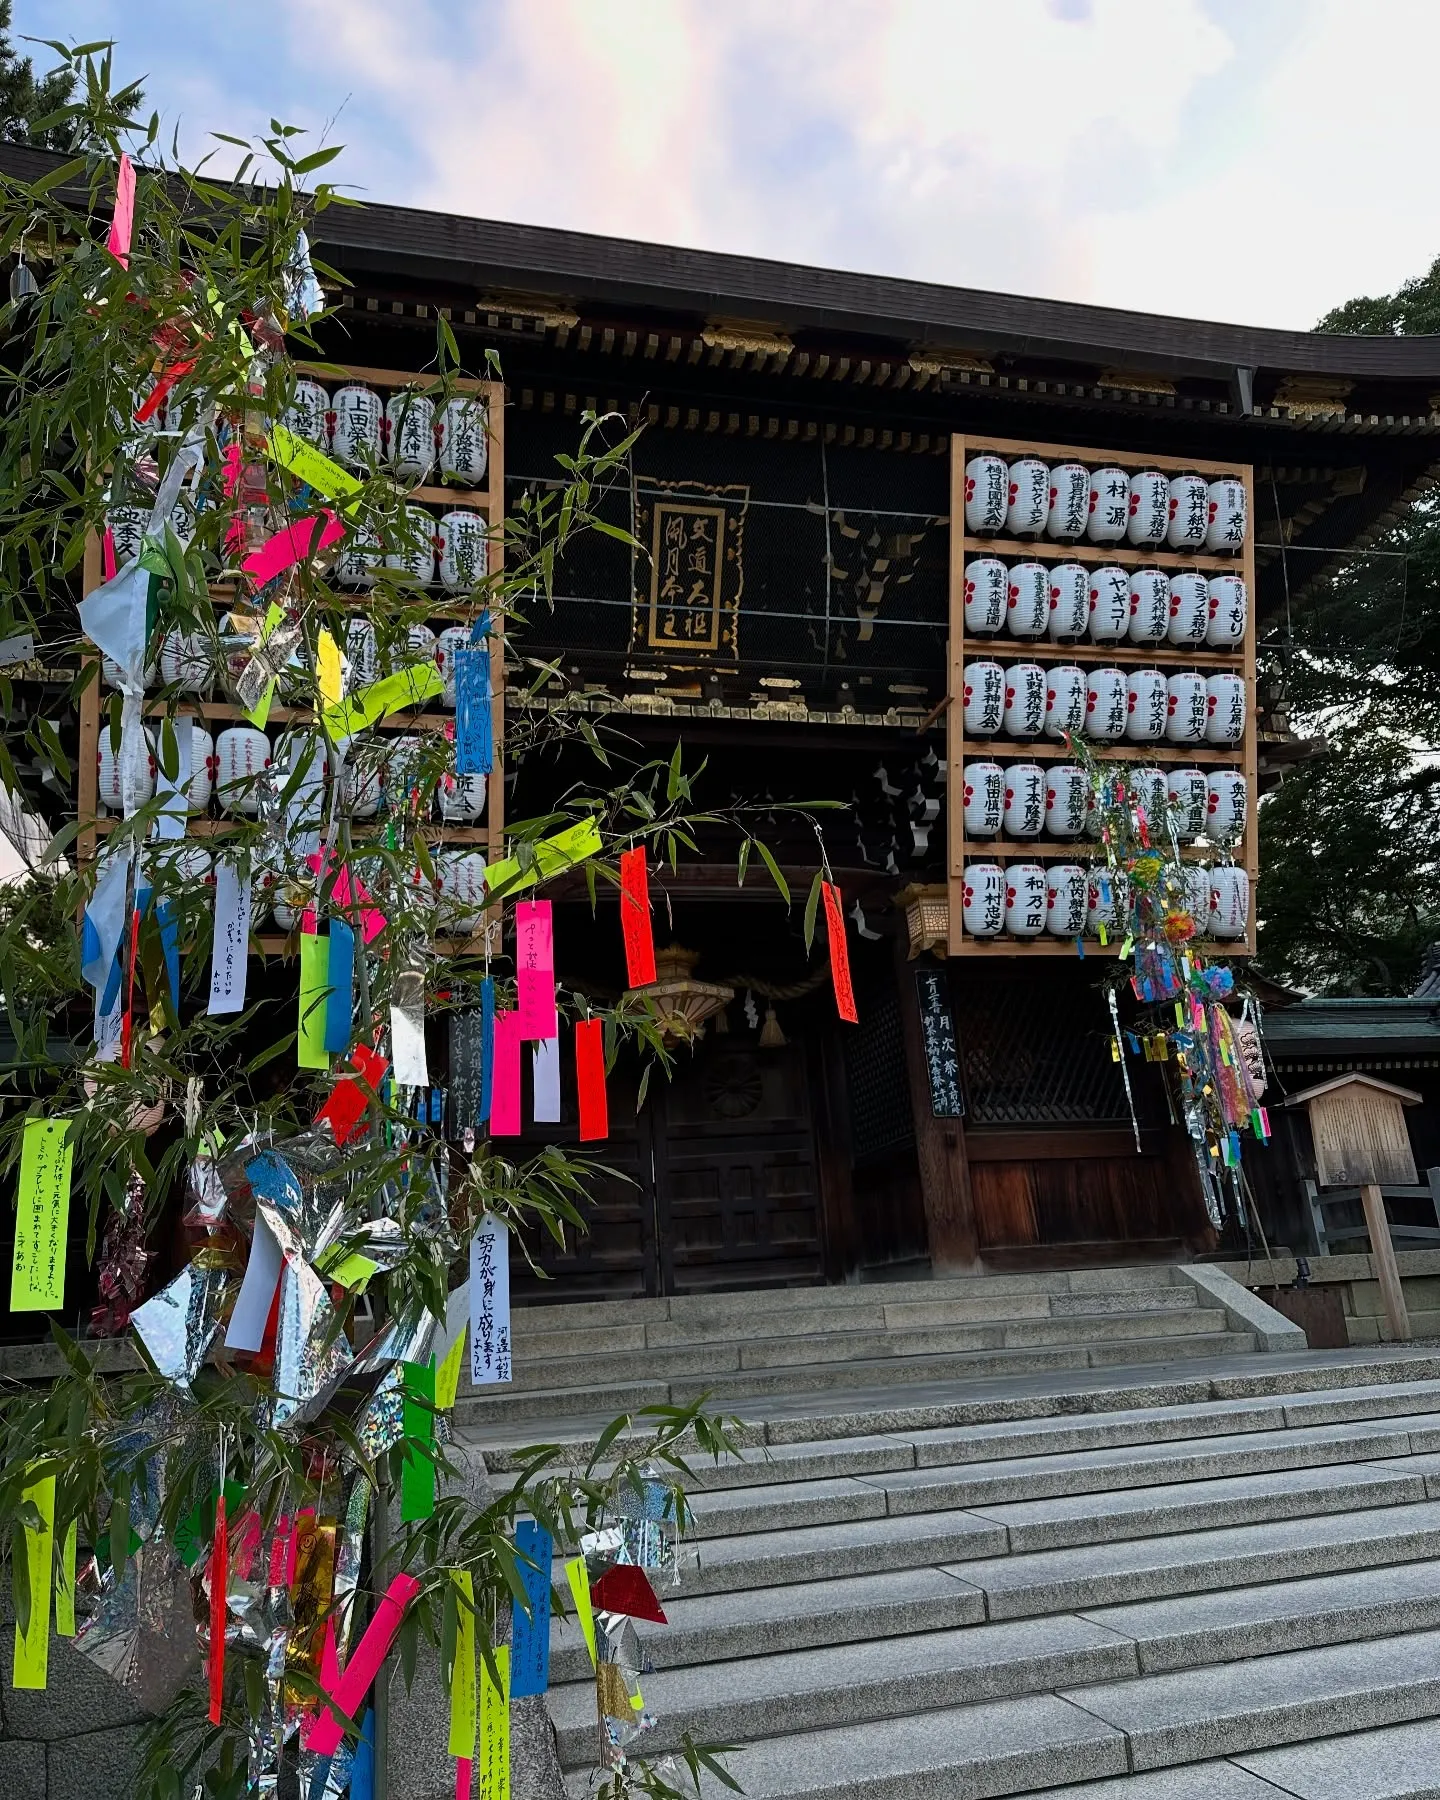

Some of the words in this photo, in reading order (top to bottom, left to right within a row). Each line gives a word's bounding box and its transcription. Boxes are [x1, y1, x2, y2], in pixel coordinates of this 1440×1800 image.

[1064, 473, 1084, 532] 柴田石材株式会社
[1106, 480, 1127, 527] 材源
[1184, 486, 1206, 539] 福井紙店
[1224, 512, 1244, 542] 老松
[1109, 578, 1126, 630] ヤギコー
[1188, 583, 1206, 638] ミラノ工務店
[1229, 608, 1243, 636] もり
[1024, 672, 1043, 732] 北野祭保存会
[1106, 688, 1124, 733] 井上経和
[1149, 689, 1165, 734] 伊吹文明
[1185, 693, 1205, 738] 初田和久
[984, 774, 1001, 829] 稲田慎一郎
[1020, 776, 1041, 831] 才本隆彦
[982, 877, 1001, 930] 川村忠史
[1026, 877, 1043, 927] 和乃匠
[939, 1015, 958, 1077] 月次祭
[477, 1234, 498, 1370] 努力が身に成ります
[473, 1338, 483, 1377] ように
